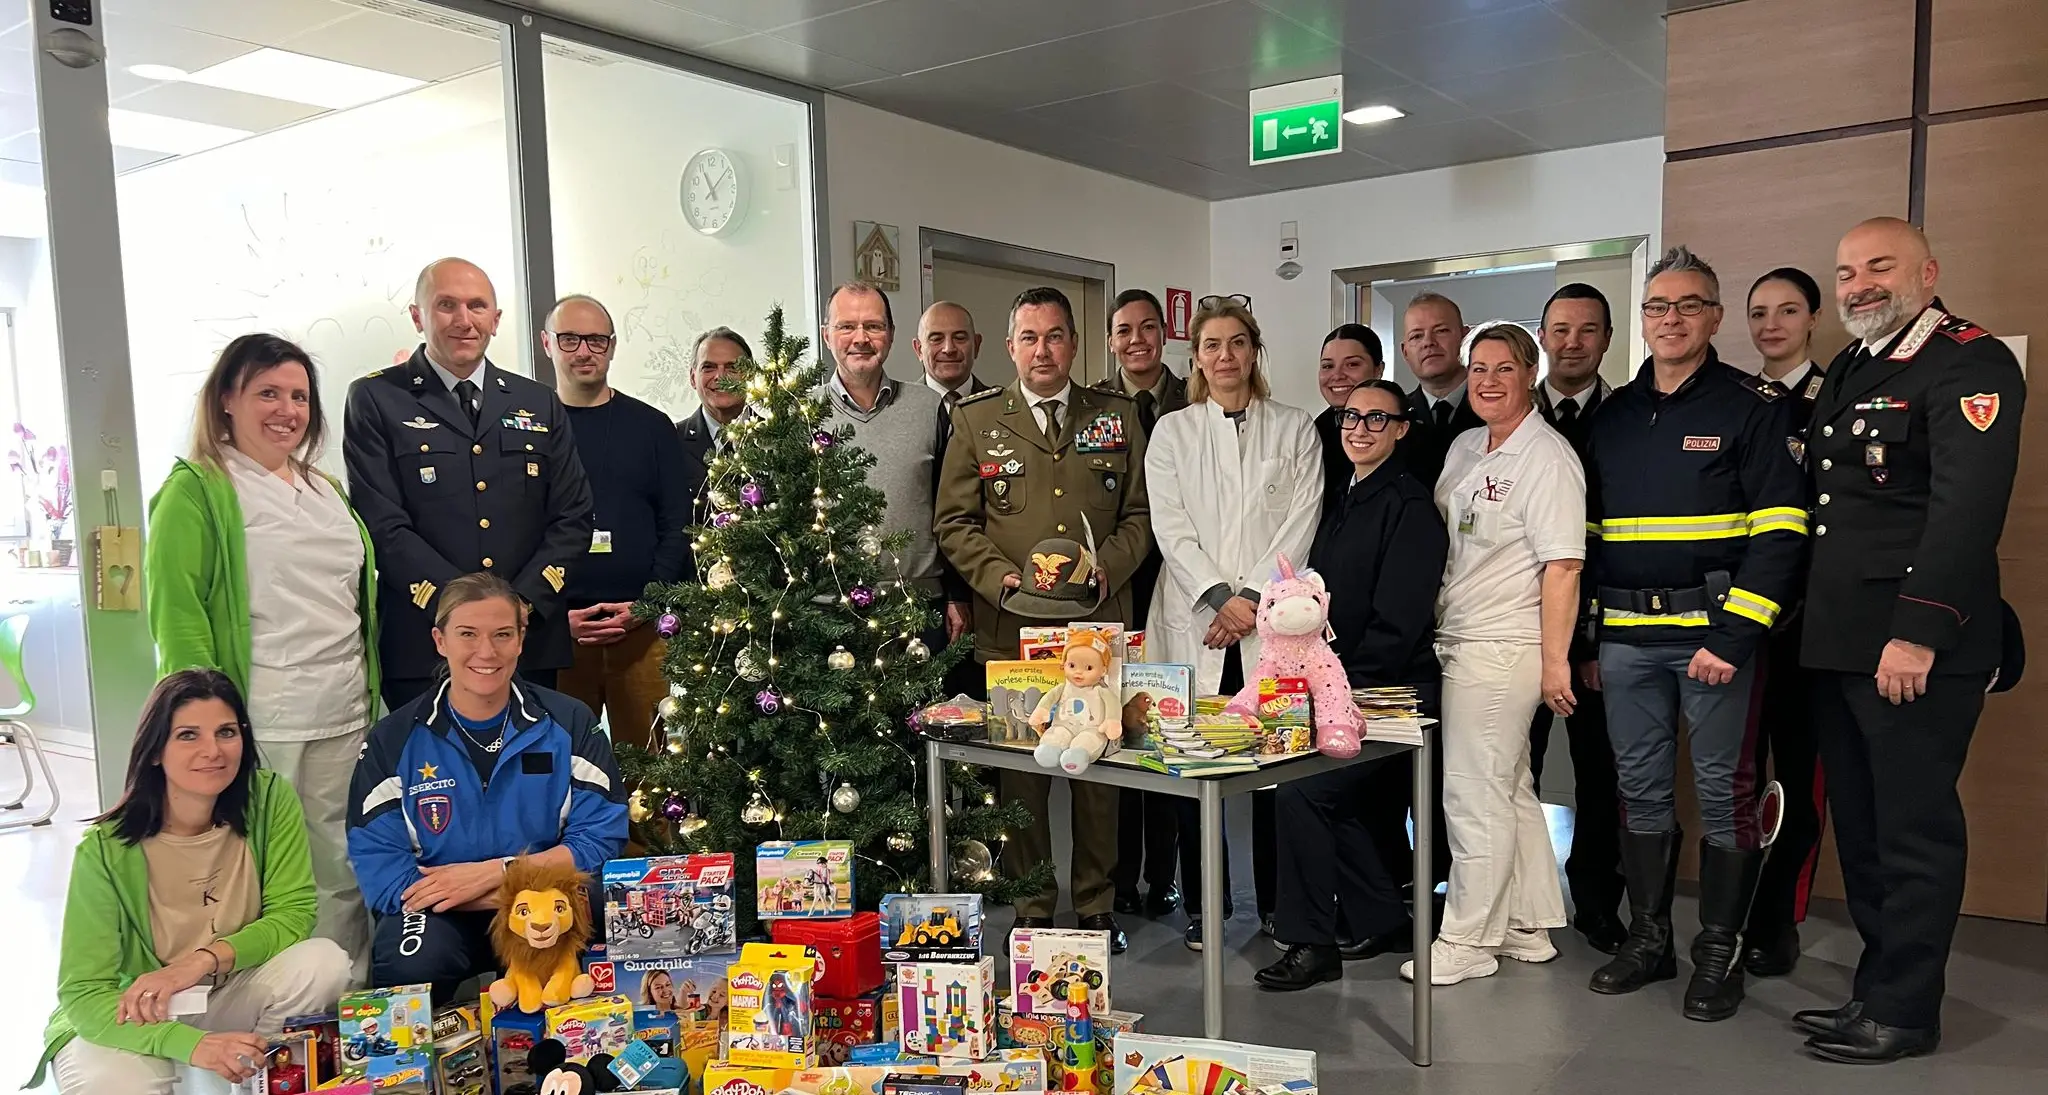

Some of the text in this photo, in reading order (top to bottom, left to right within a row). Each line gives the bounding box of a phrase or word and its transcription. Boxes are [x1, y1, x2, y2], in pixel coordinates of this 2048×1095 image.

[708, 156, 716, 167] 12
[727, 169, 733, 179] 2
[693, 176, 700, 187] 10
[690, 192, 696, 202] 9
[694, 207, 700, 217] 8
[702, 216, 707, 226] 7
[722, 213, 728, 222] 5
[712, 219, 718, 229] 6
[1685, 439, 1717, 448] POLIZIA
[1121, 679, 1180, 693] orlese-Fühlbuch
[1262, 697, 1289, 714] UNO
[408, 778, 456, 796] ESERCITO
[757, 849, 785, 857] playmobil
[604, 870, 641, 880] playmobil
[659, 868, 687, 876] CITY
[700, 876, 724, 885] PACK
[806, 948, 816, 956] 4+
[624, 958, 693, 972] Quadrilla
[732, 995, 760, 1008] MARVEL
[356, 1006, 382, 1016] duplo
[814, 1007, 838, 1017] UPER
[814, 1016, 843, 1028] ARIO
[967, 1079, 993, 1090] uplo
